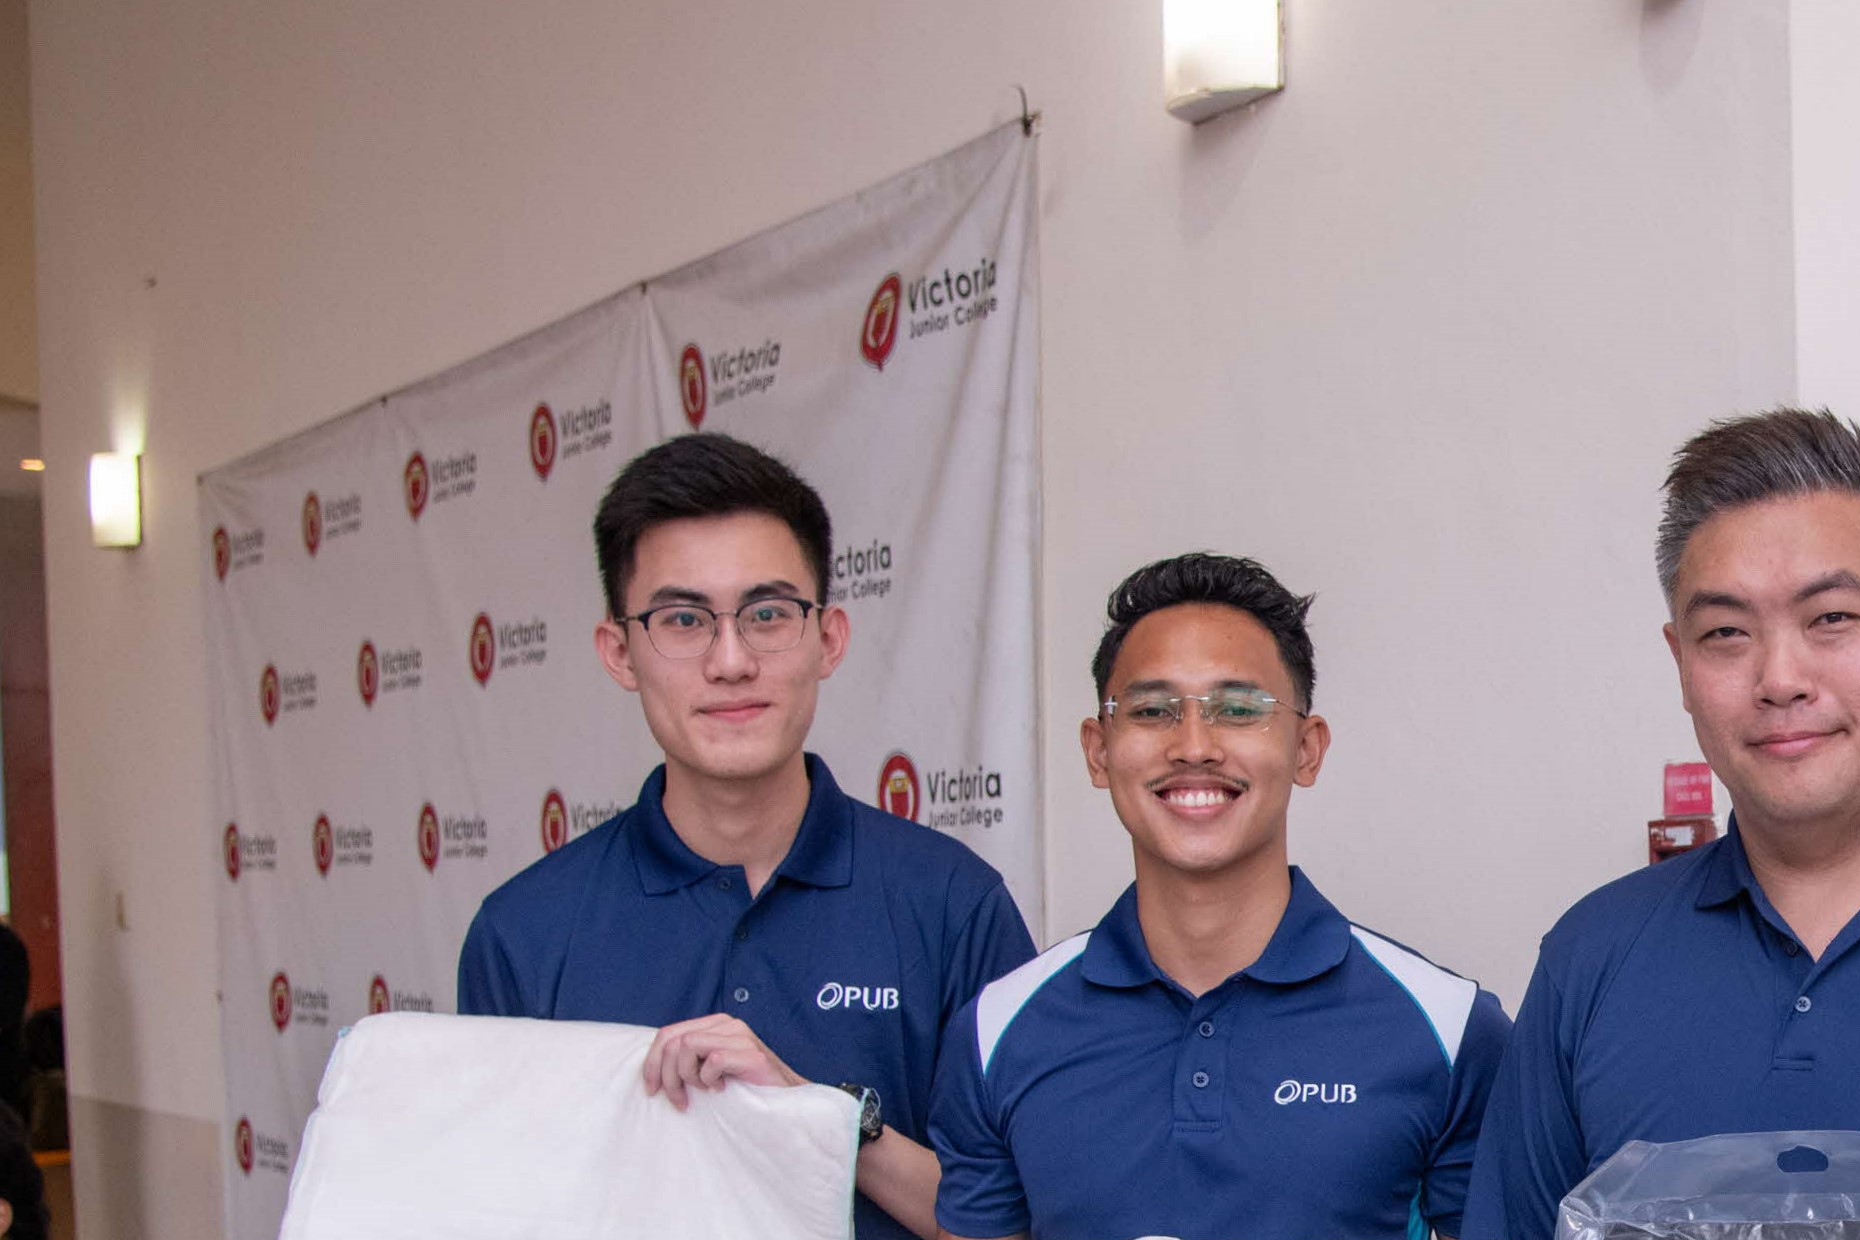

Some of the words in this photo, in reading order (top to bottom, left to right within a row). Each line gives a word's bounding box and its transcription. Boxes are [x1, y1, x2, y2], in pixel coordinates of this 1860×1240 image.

[908, 257, 996, 314] Victoria
[910, 314, 949, 339] Junior
[955, 297, 997, 326] College
[711, 338, 781, 385] Victoria
[560, 401, 612, 437] Victoria
[432, 451, 477, 484] Victoria
[834, 540, 891, 579] ctoria
[852, 578, 891, 600] College
[500, 618, 547, 648] Victoria
[382, 648, 422, 675] Victoria
[927, 764, 1002, 805] Victoria
[444, 812, 487, 842] Victoria
[929, 808, 958, 830] Junior
[961, 806, 1003, 829] College
